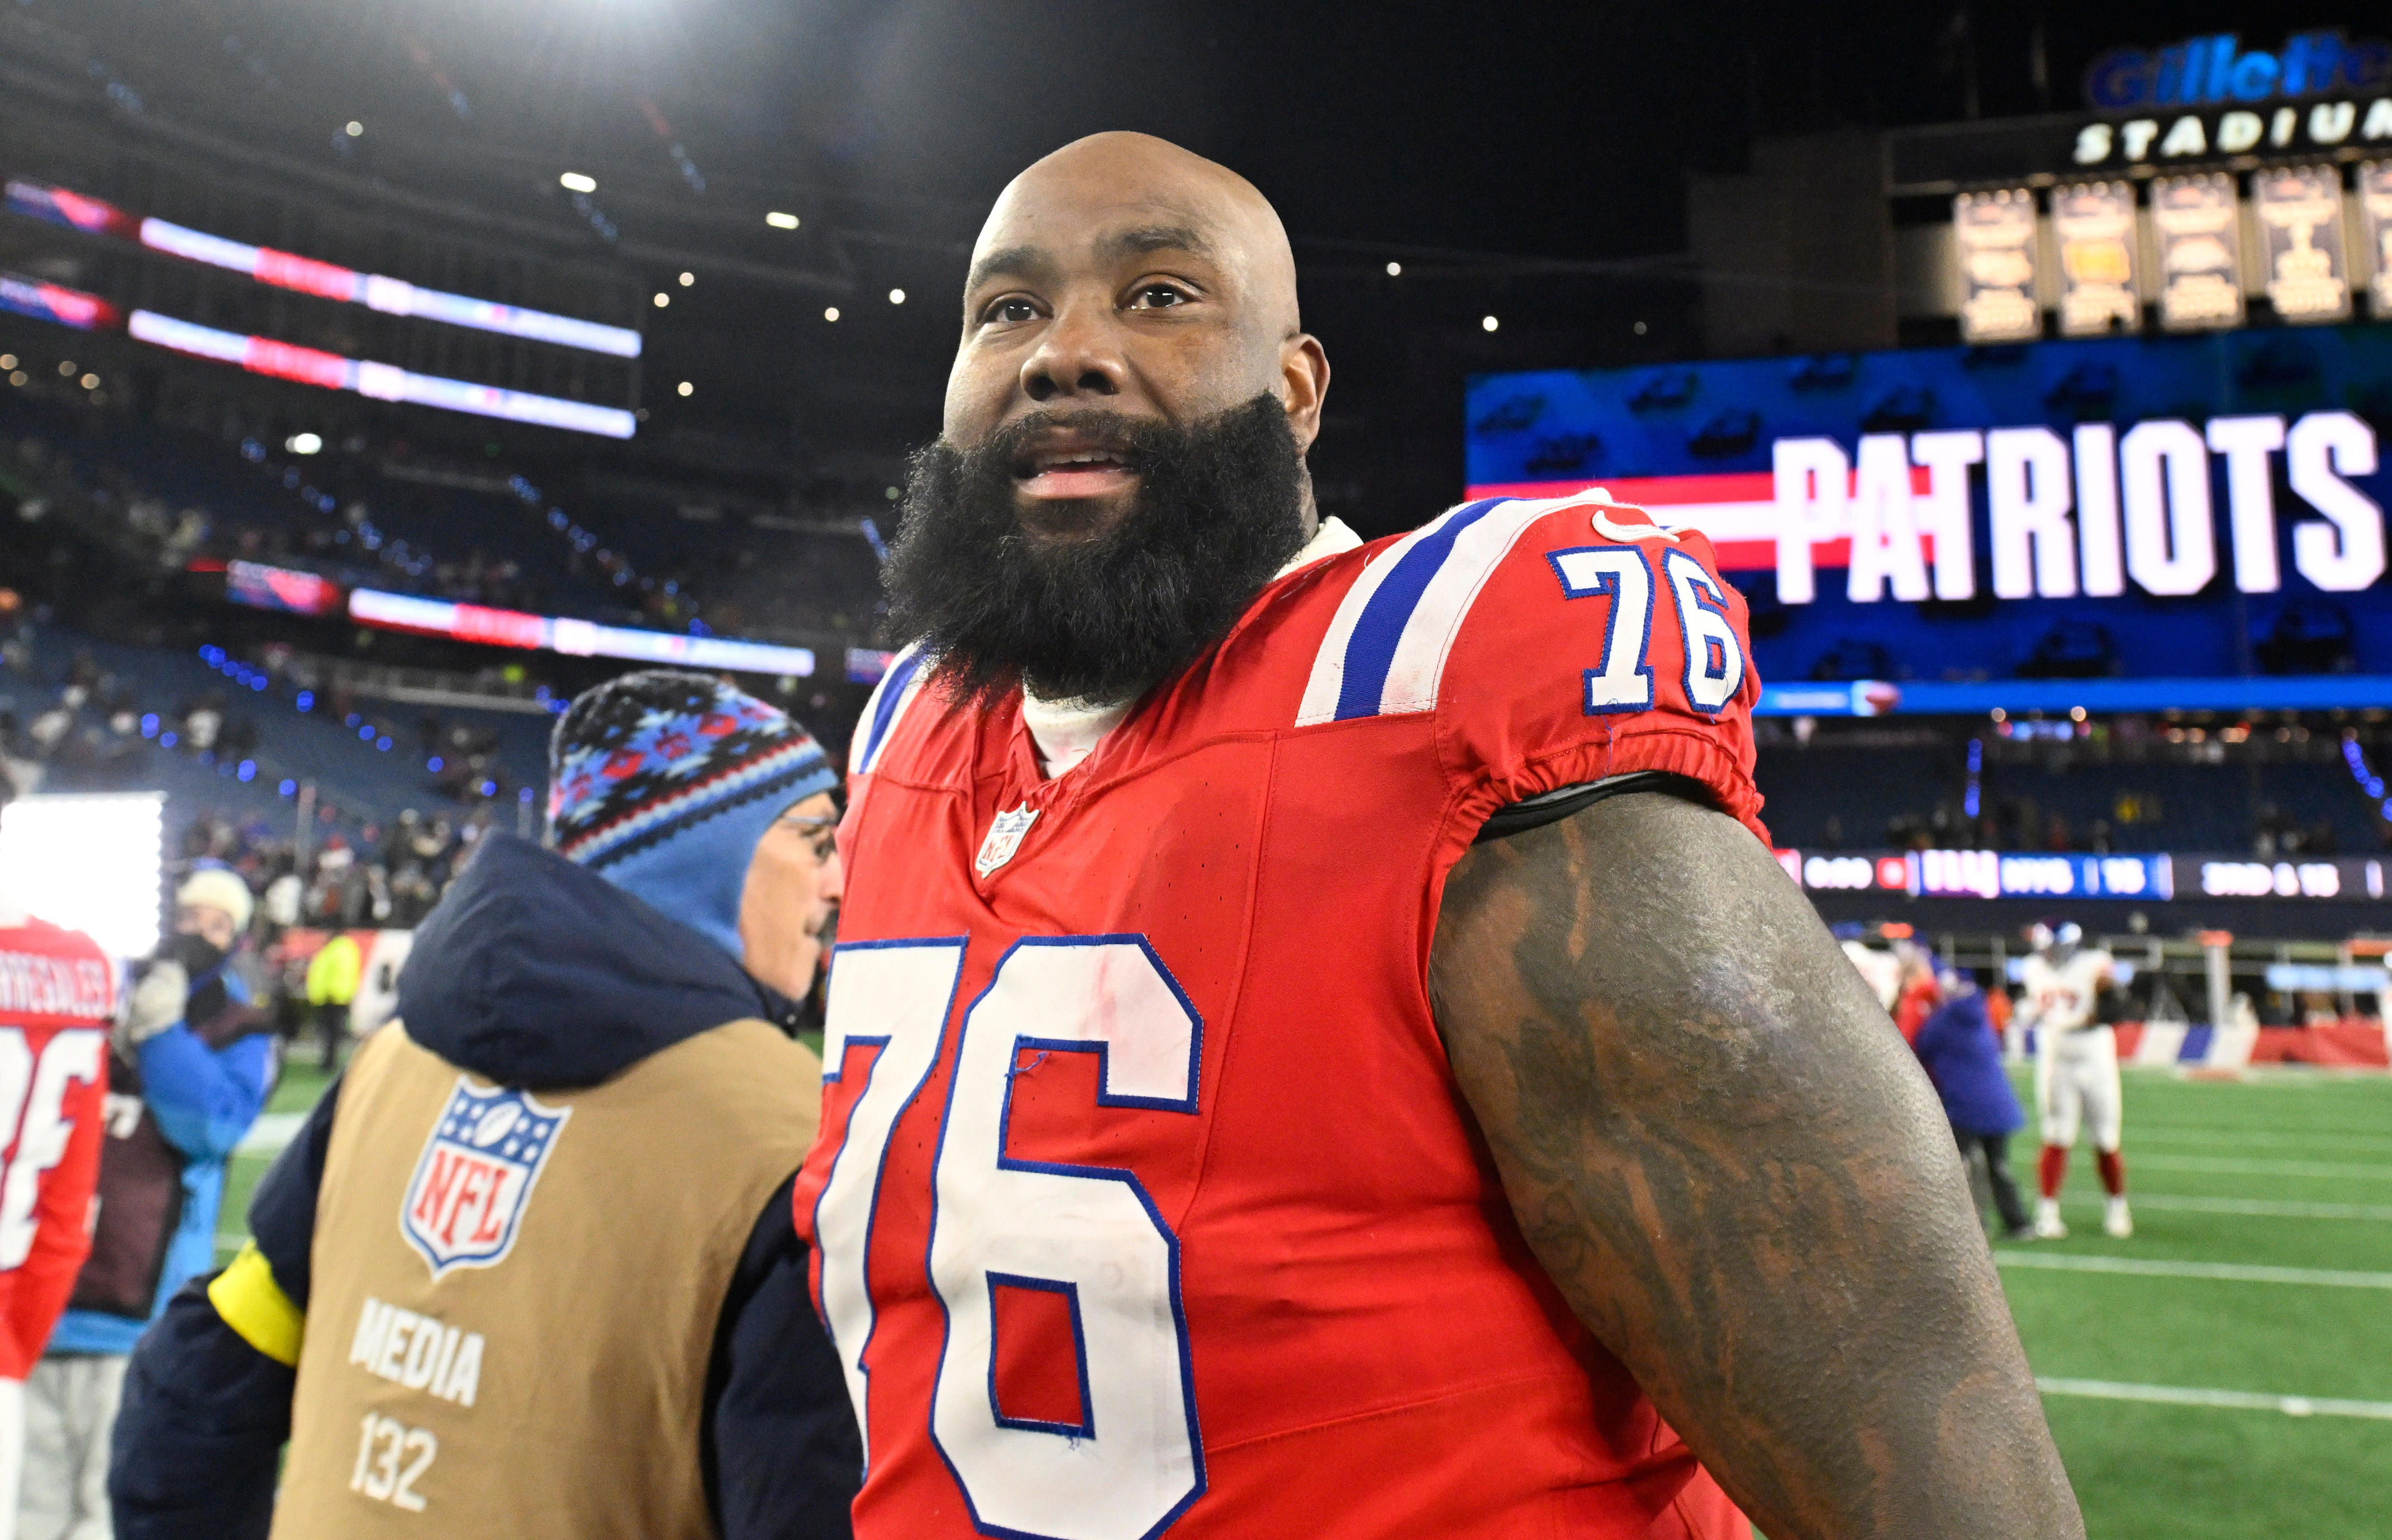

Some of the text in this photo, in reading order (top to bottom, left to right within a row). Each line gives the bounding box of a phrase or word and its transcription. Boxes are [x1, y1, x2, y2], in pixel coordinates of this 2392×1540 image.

[1773, 410, 2386, 605] PATRIOTS
[1545, 545, 1746, 716] 76
[982, 834, 1015, 863] NFL
[414, 1149, 508, 1248] NFL
[813, 932, 1208, 1540] 76
[349, 1296, 486, 1408] MEDIA
[350, 1411, 439, 1512] 132
